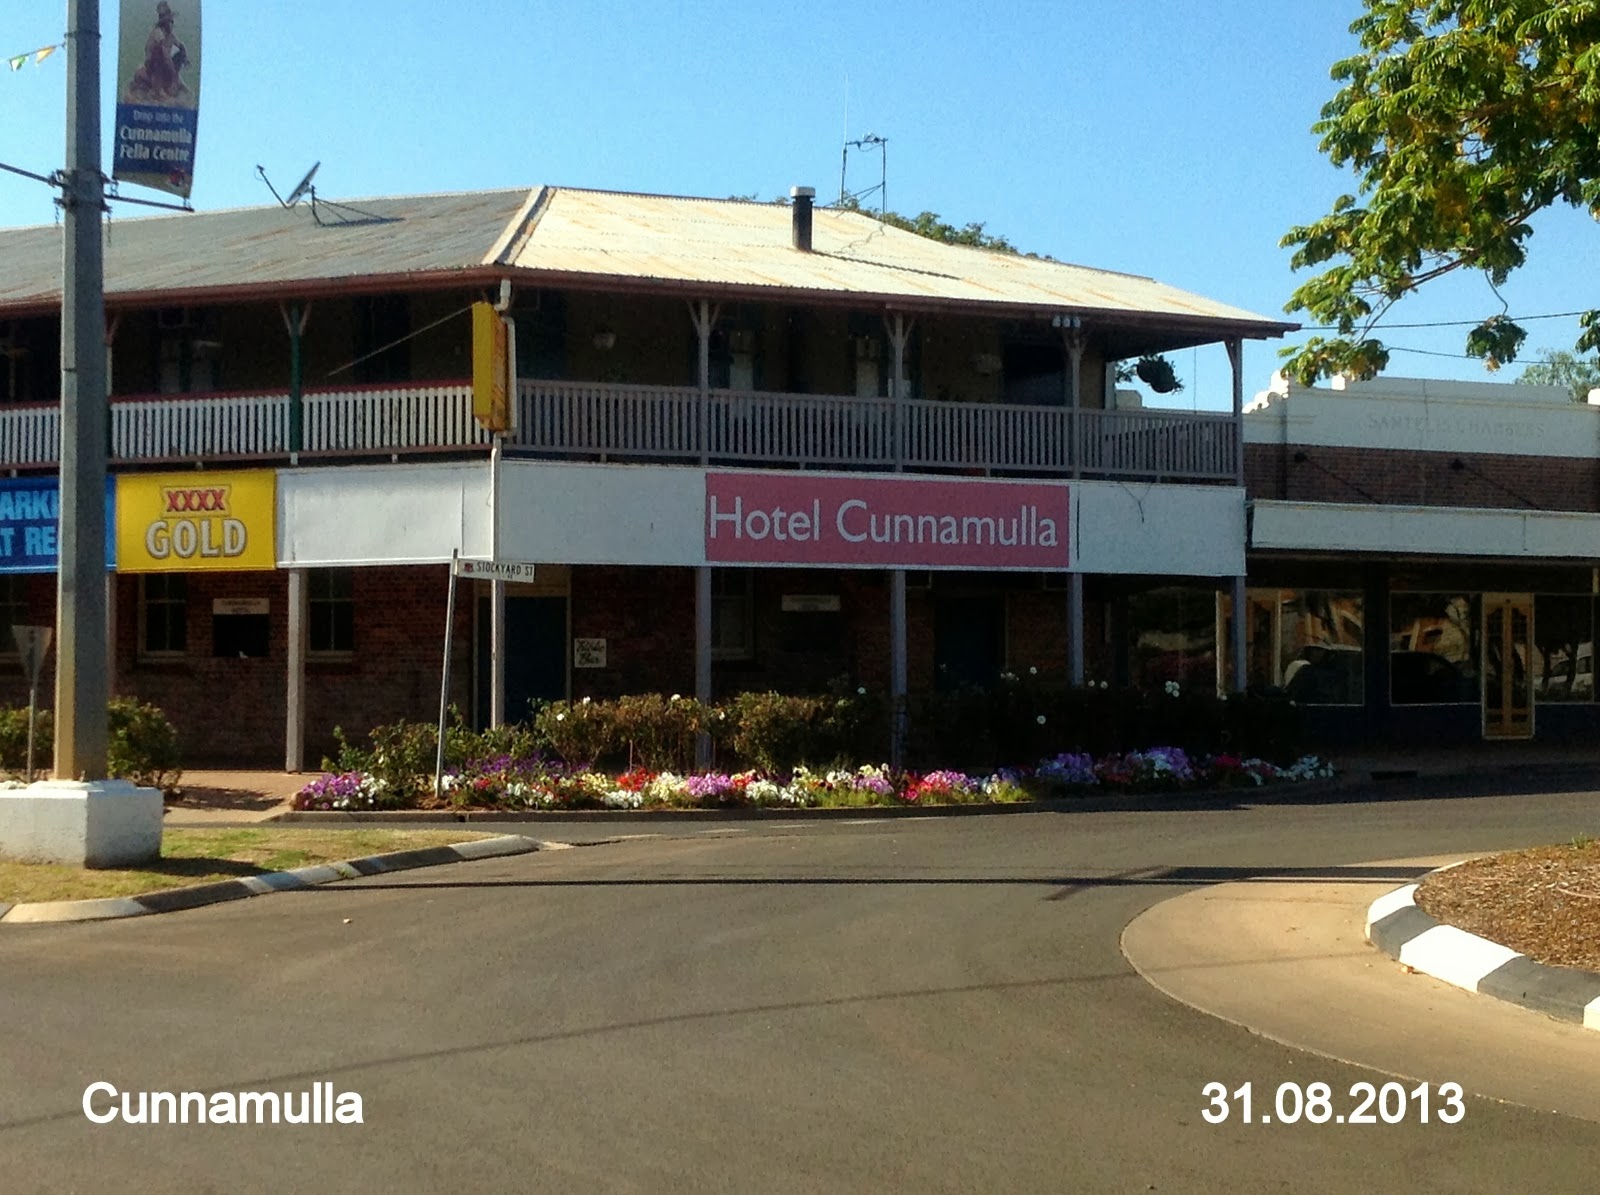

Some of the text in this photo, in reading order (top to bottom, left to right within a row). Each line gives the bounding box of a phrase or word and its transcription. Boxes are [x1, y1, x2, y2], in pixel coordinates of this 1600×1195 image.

[120, 125, 192, 144] Cunnamulla
[120, 143, 190, 162] Fella Centre
[166, 489, 226, 512] XXXX
[709, 495, 1058, 547] Hotel Cunnamulla
[145, 518, 248, 559] GOLD
[476, 561, 522, 576] STOCKYARD
[524, 565, 534, 577] ST
